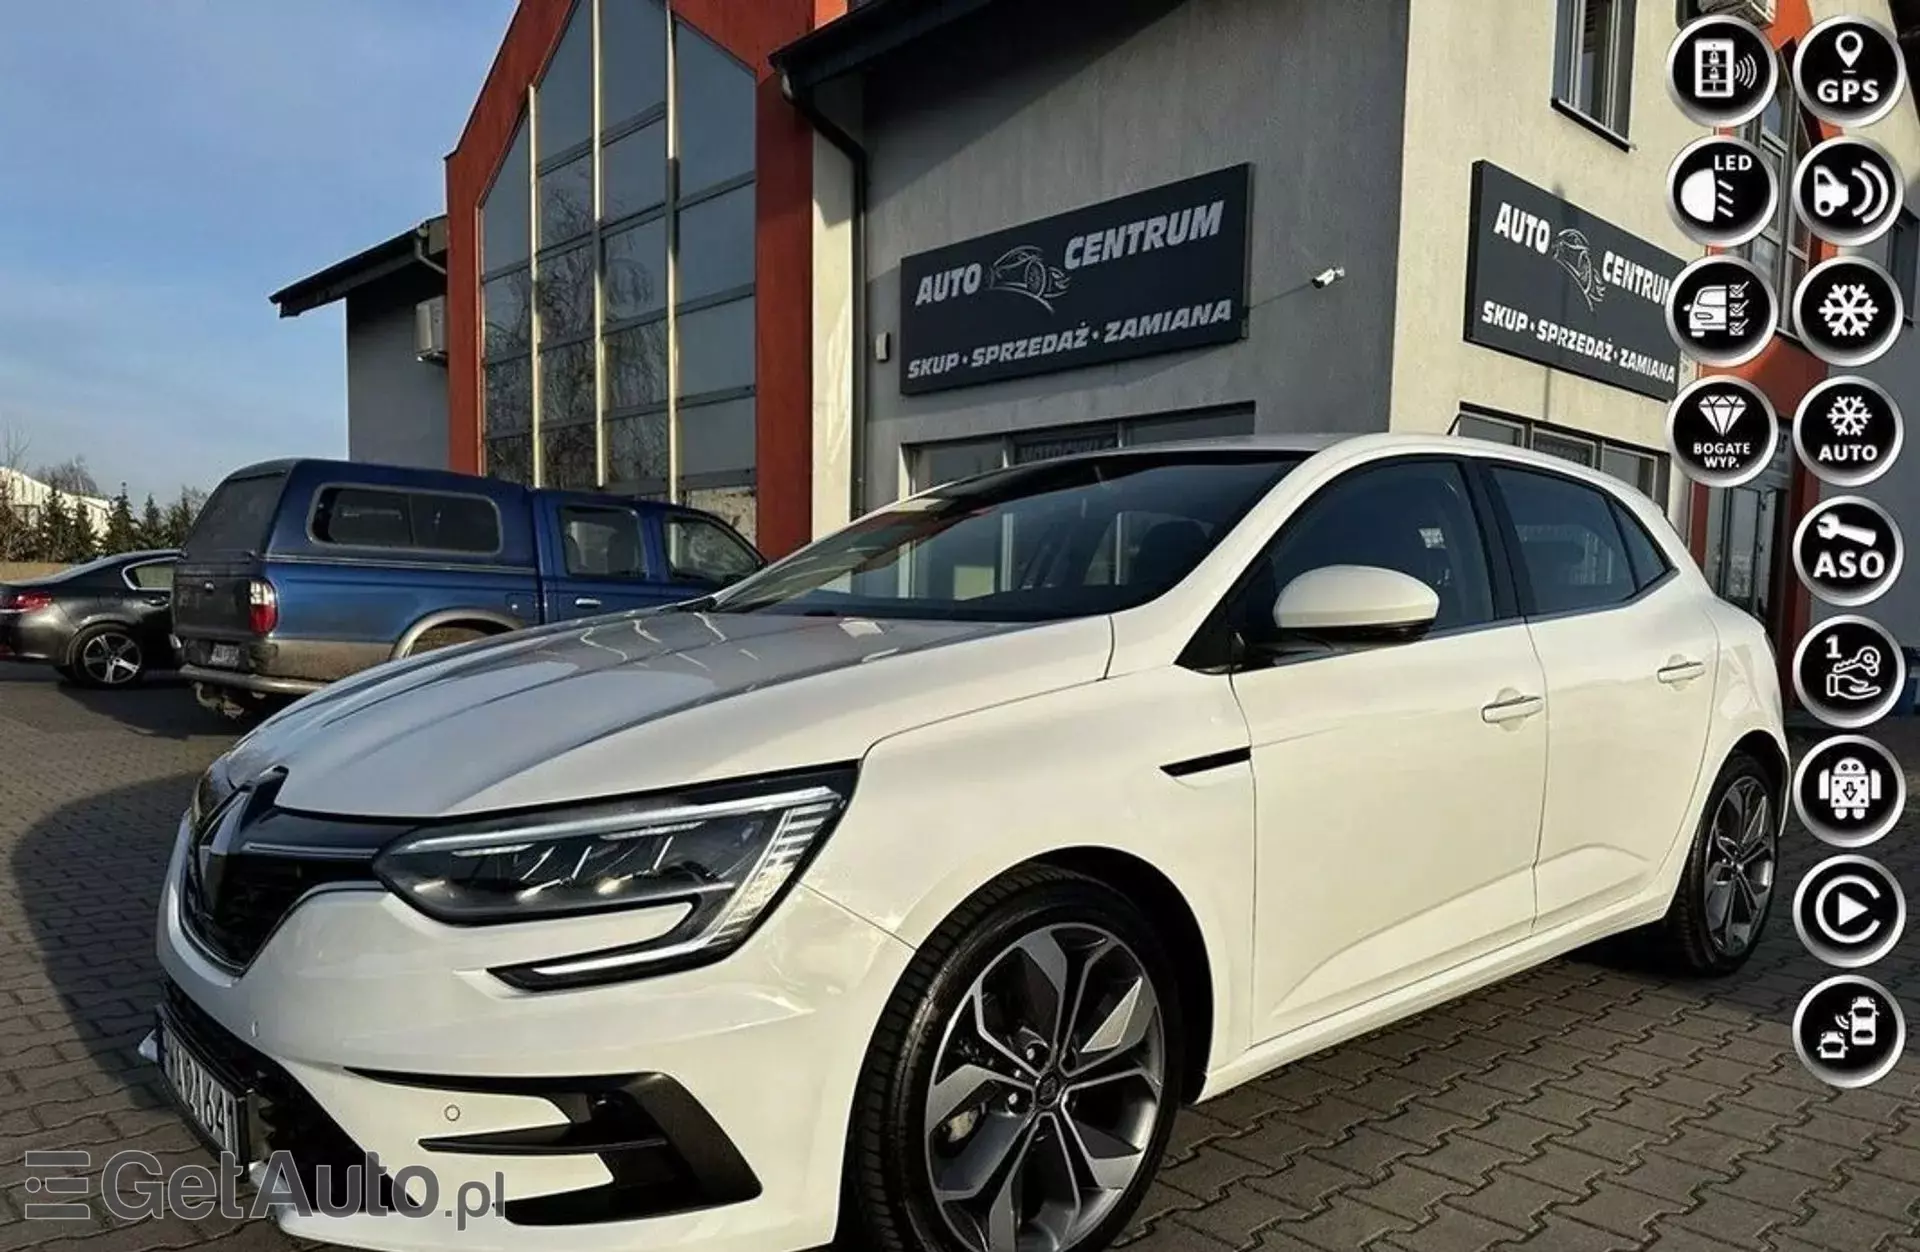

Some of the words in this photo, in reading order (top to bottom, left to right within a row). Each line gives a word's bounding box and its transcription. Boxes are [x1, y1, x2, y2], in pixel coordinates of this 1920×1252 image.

[915, 262, 982, 306] AUTO
[1064, 200, 1225, 270] CENTRUM
[1493, 202, 1550, 255] AUTO
[908, 352, 958, 379] SKUP
[970, 322, 1089, 368] SPRZEDAŻ
[1103, 299, 1232, 343] ZAMIANA
[1481, 300, 1528, 332] SKUP
[1536, 318, 1614, 362] SPRZEDAŻ
[1619, 348, 1676, 384] ZAMIANA
